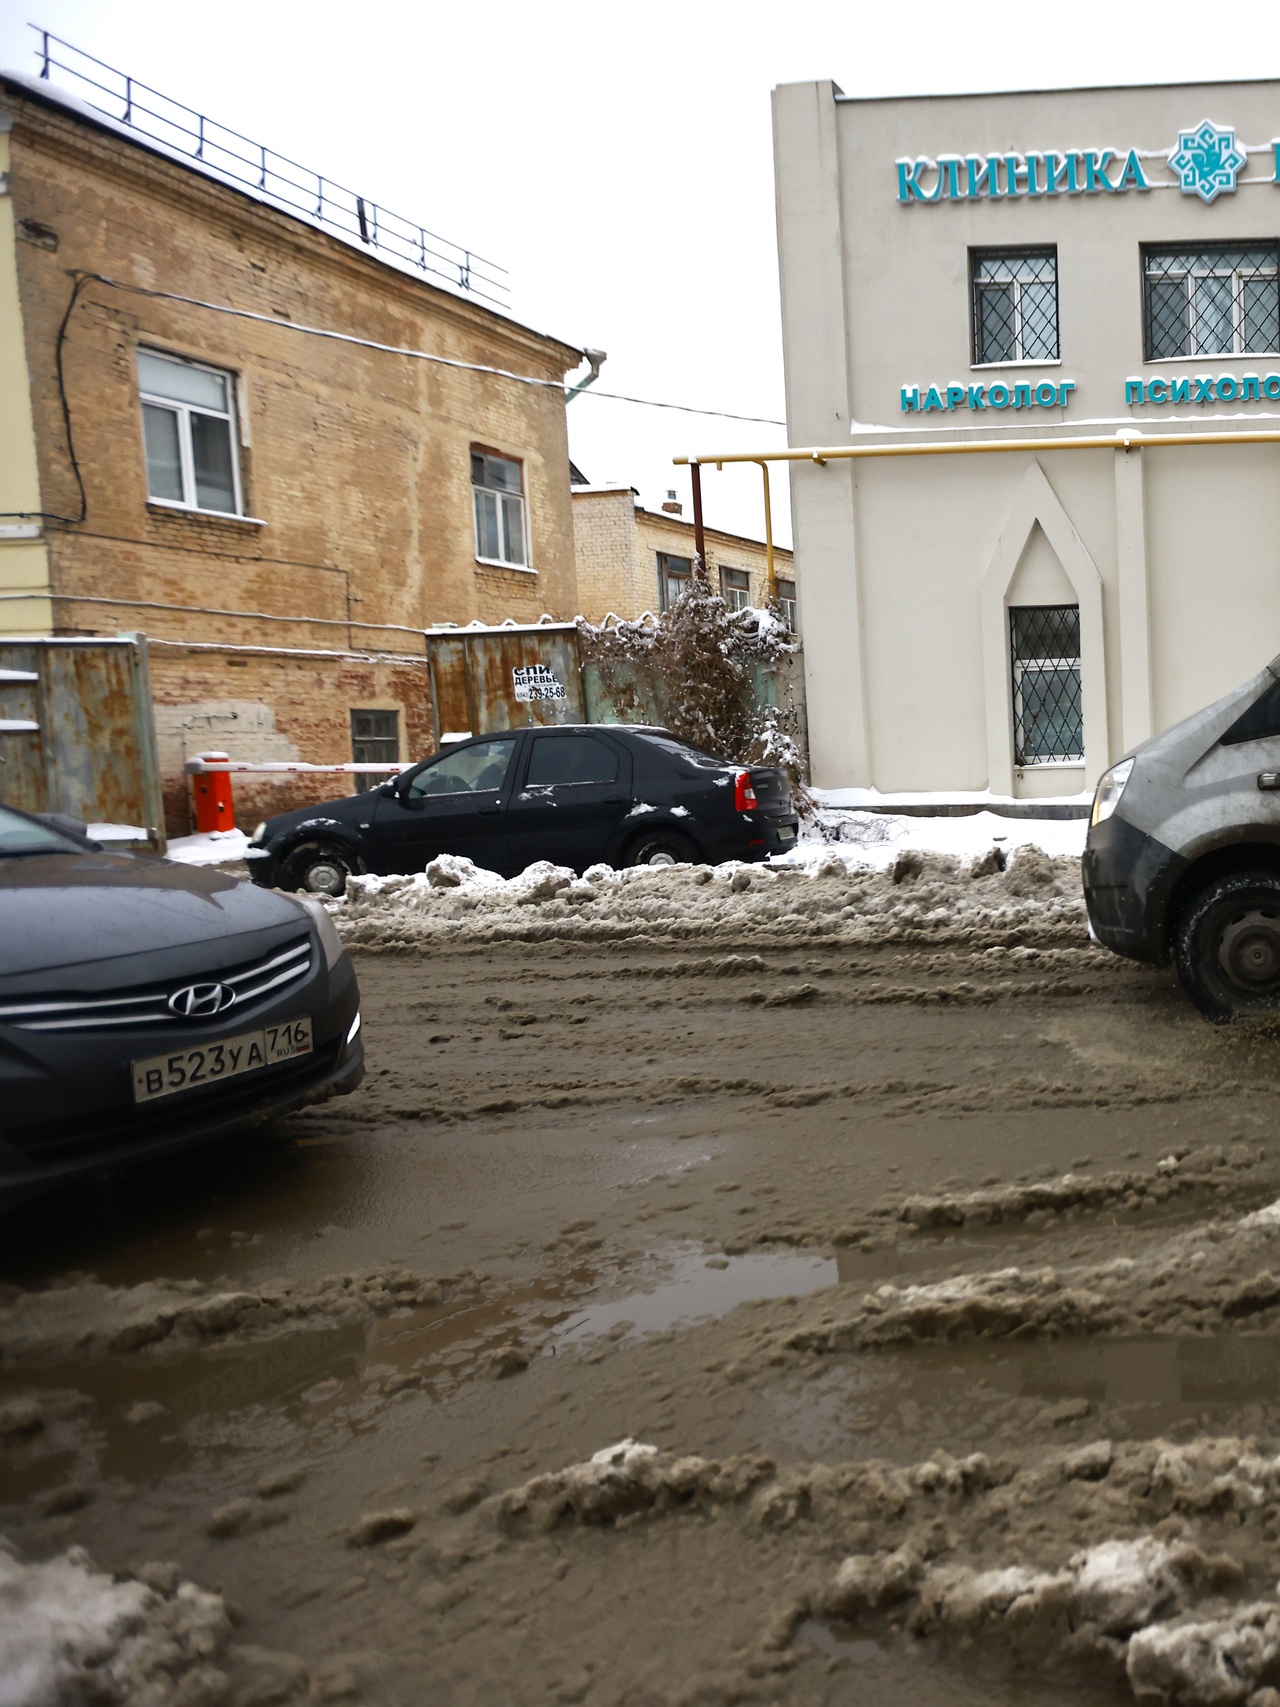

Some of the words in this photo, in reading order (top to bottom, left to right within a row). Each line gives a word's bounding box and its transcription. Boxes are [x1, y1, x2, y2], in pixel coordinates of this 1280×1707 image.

[895, 149, 1150, 203] КЛИНИКА
[900, 381, 1077, 412] НАРКОЛОГ
[145, 1042, 263, 1095] В523УА
[266, 1022, 305, 1051] 716
[276, 1045, 296, 1059] RUS
